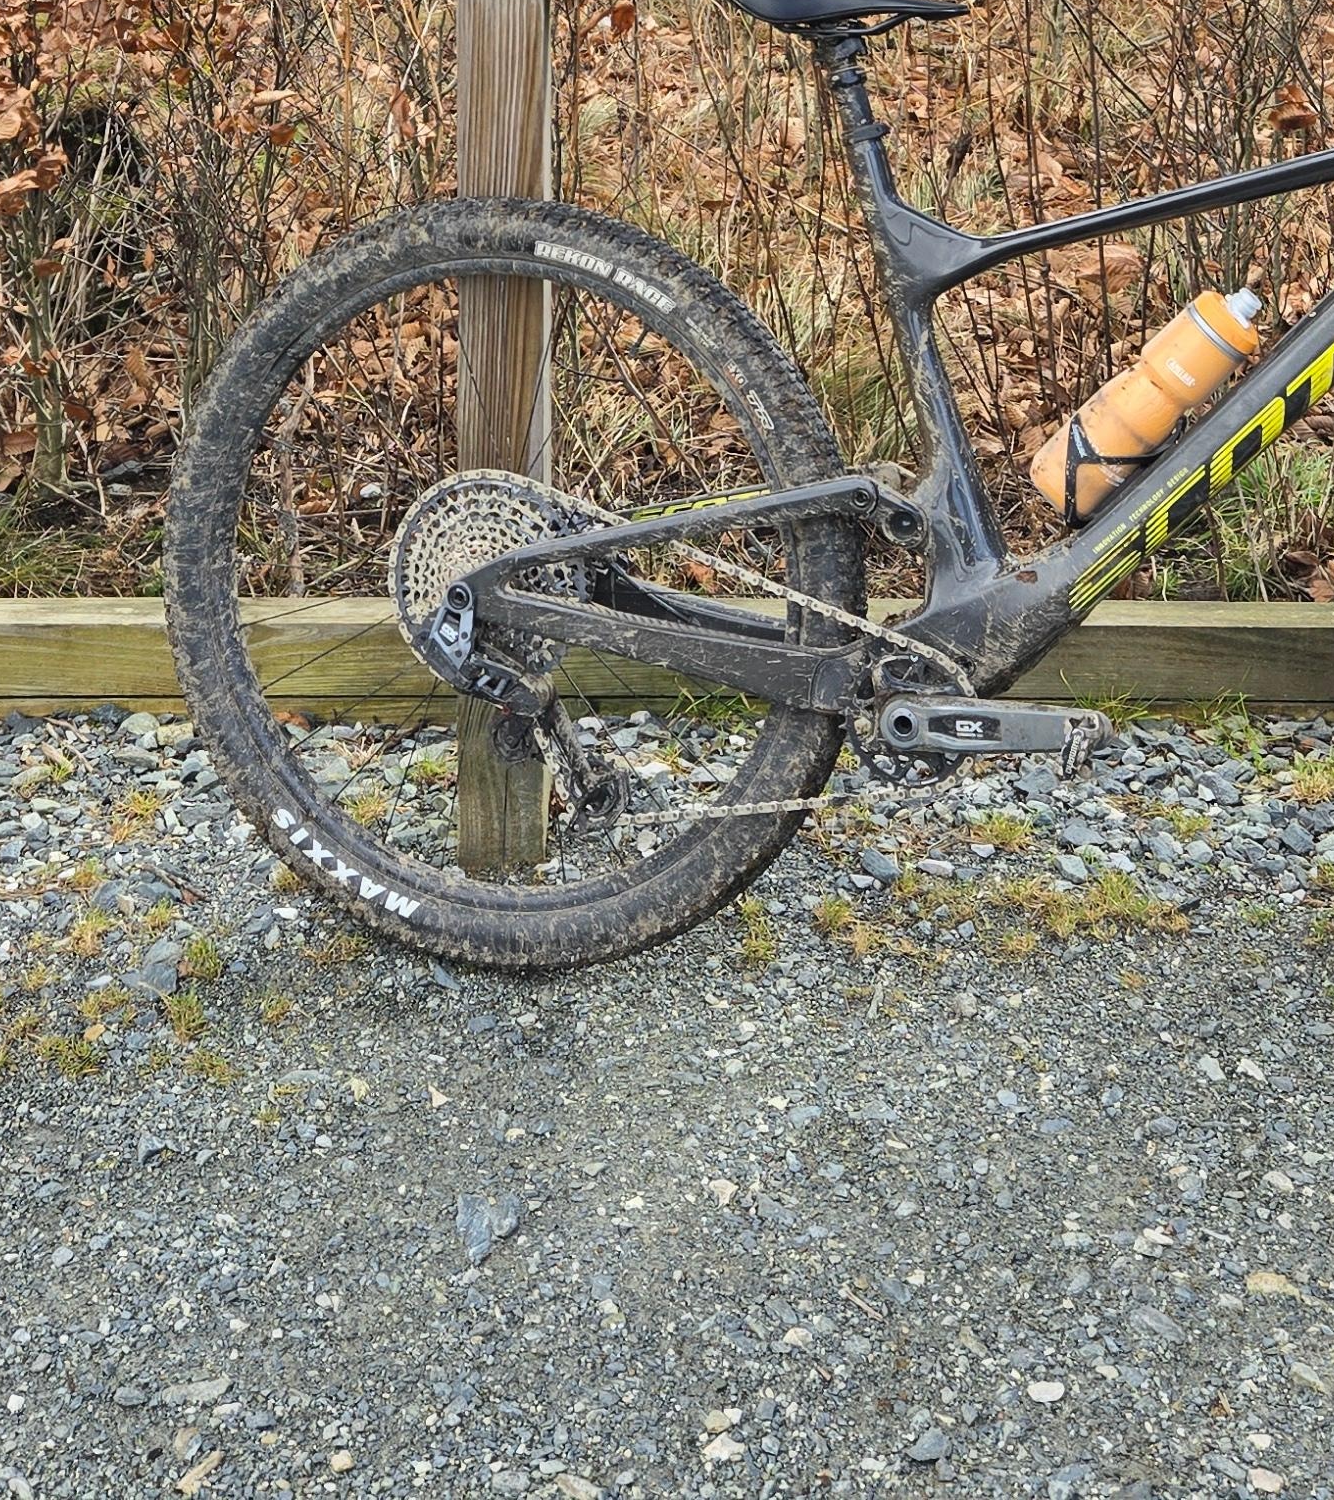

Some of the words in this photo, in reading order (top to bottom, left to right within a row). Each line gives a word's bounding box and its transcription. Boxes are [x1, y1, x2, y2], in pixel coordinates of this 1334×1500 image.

[534, 240, 614, 278] REKON
[612, 266, 677, 314] RACE
[1092, 522, 1127, 554] INNOVATION
[1128, 488, 1165, 522] TECHNOLOGY
[1166, 467, 1189, 488] DESIGN
[955, 720, 984, 733] GX
[271, 808, 421, 919] MAXXIS
